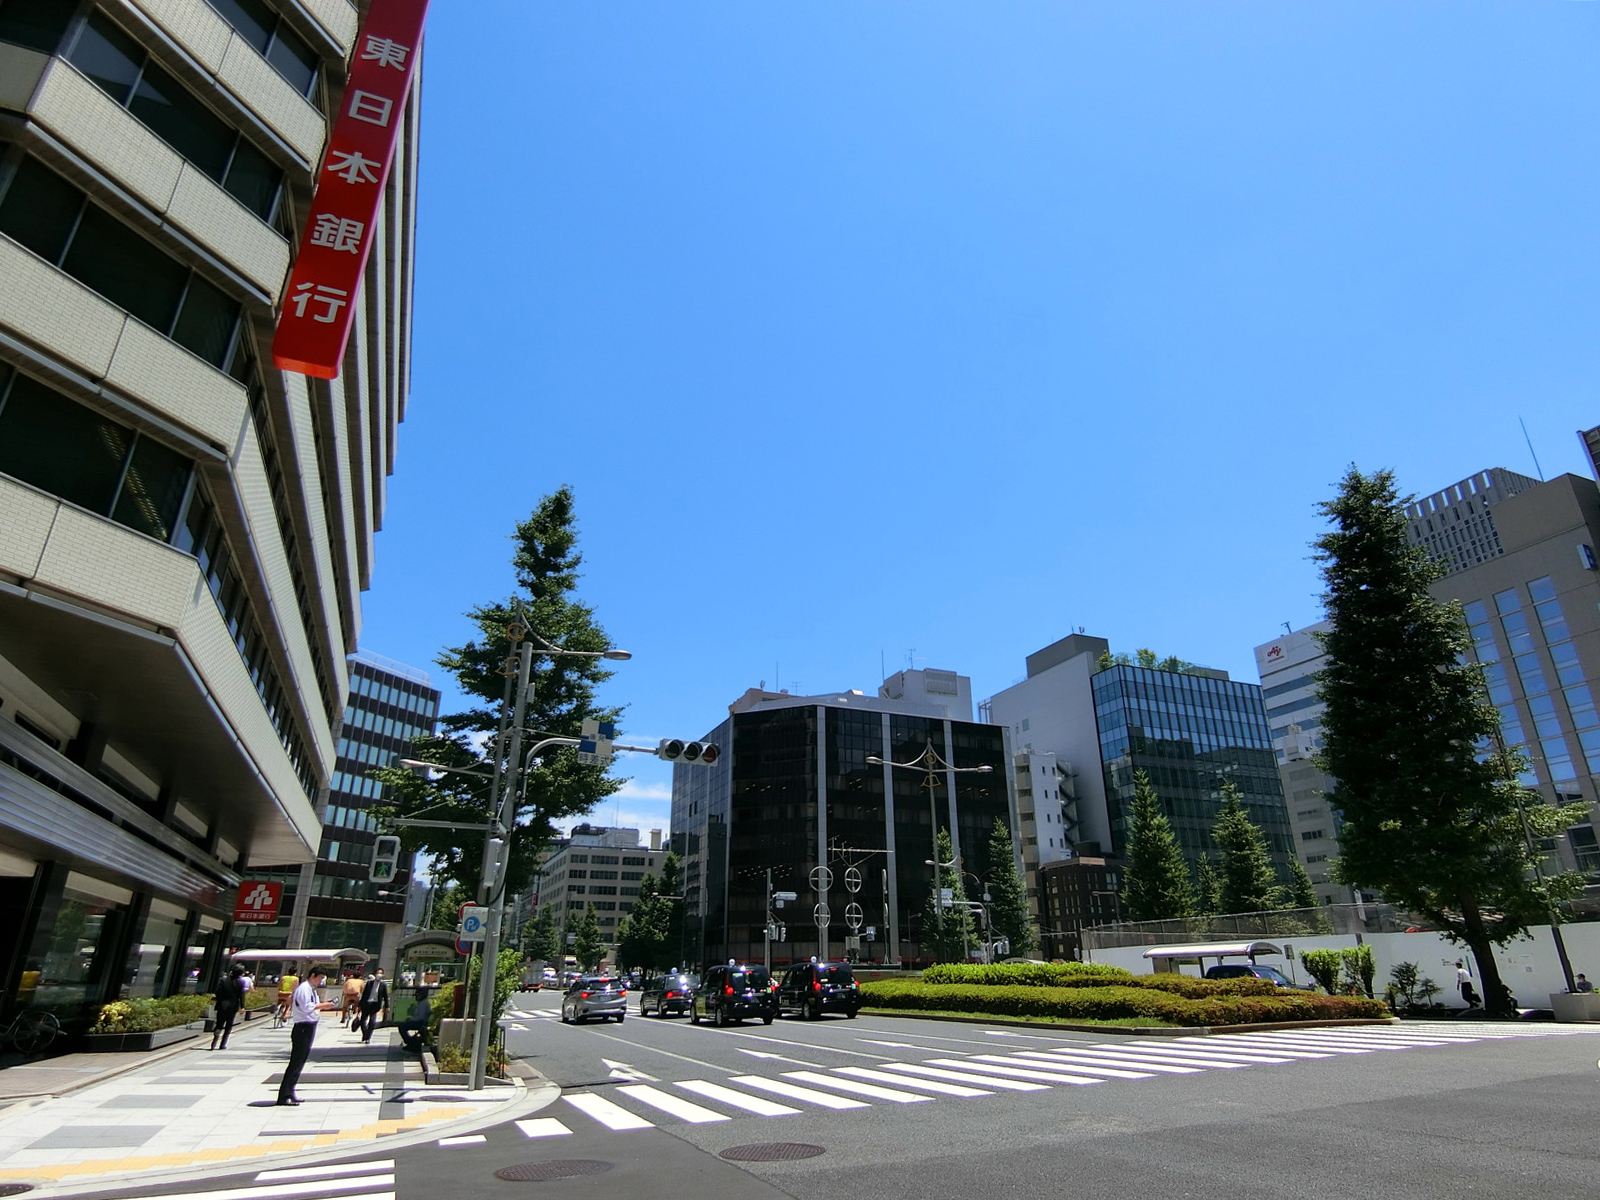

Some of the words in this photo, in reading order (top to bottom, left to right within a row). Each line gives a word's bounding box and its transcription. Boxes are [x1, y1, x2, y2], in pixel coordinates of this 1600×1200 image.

[292, 34, 410, 323] 東日本銀行
[579, 753, 610, 766] 時差式
